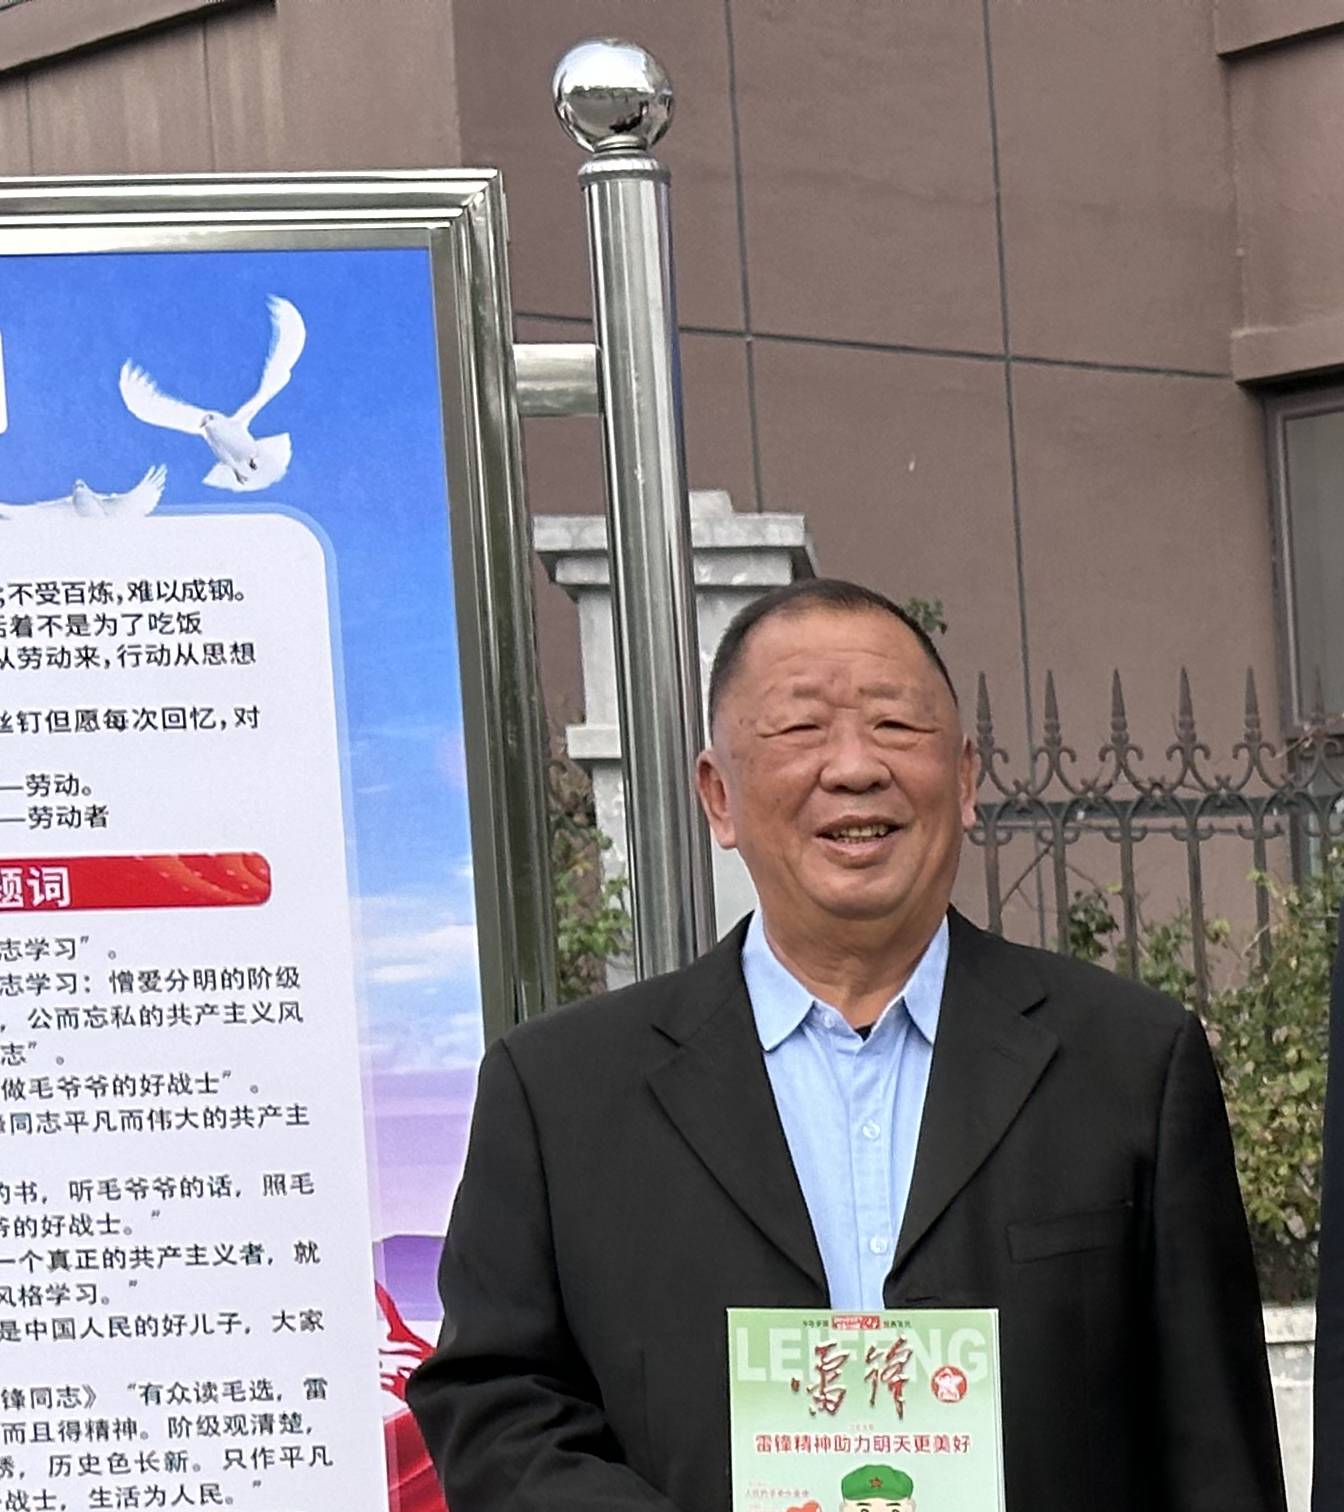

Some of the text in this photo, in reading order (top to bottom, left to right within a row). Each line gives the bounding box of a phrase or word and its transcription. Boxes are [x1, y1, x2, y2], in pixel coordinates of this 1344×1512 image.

[0, 1104, 310, 1136] 同志平凡而伟大的共产主
[755, 1434, 971, 1455] 雷锋精神助力明天更美好
[0, 1480, 262, 1512] 战士，生活为人民。”
